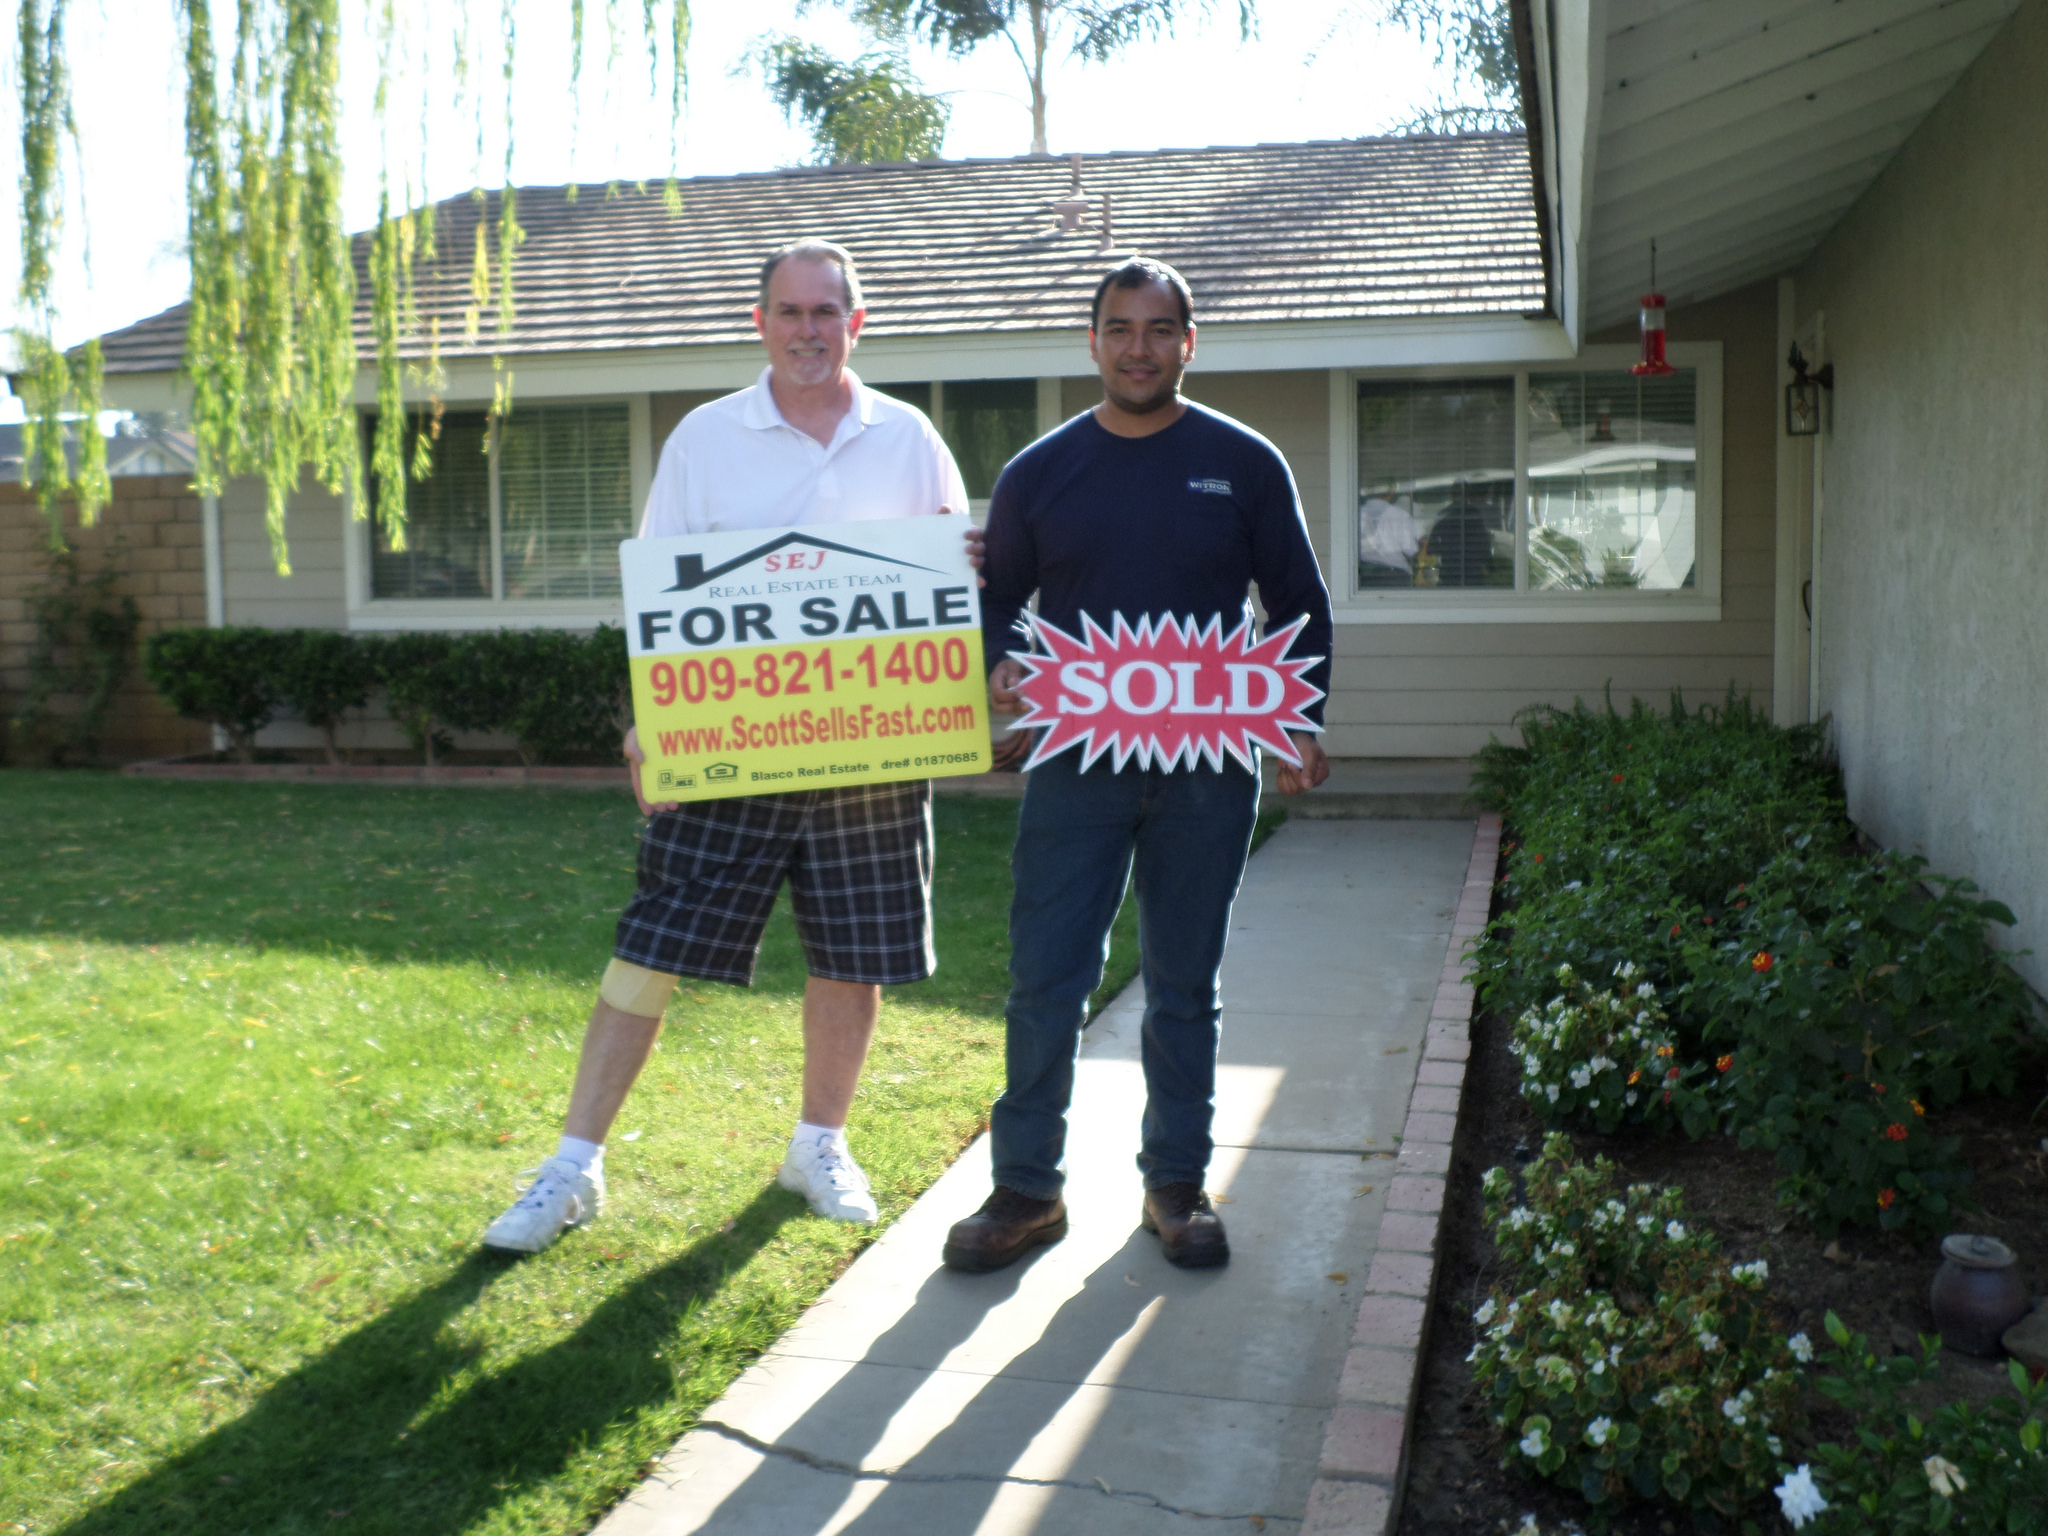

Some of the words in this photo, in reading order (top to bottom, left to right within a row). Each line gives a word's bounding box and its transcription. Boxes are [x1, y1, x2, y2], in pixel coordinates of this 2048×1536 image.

[1189, 481, 1230, 491] WITRON
[764, 550, 829, 573] SEJ
[708, 585, 762, 599] REAL
[767, 578, 840, 594] ESTATE
[843, 572, 903, 588] TEAM
[637, 602, 778, 651] FOR
[798, 586, 973, 637] SALE
[649, 636, 970, 707] 909-821-1400
[1056, 660, 1286, 716] SOLD
[656, 702, 976, 757] www.ScottSellsFast.com
[751, 771, 794, 782] Blasco
[797, 766, 826, 778] Real
[829, 762, 870, 775] Estate
[880, 758, 910, 770] dre#
[914, 752, 979, 767] 01870685
